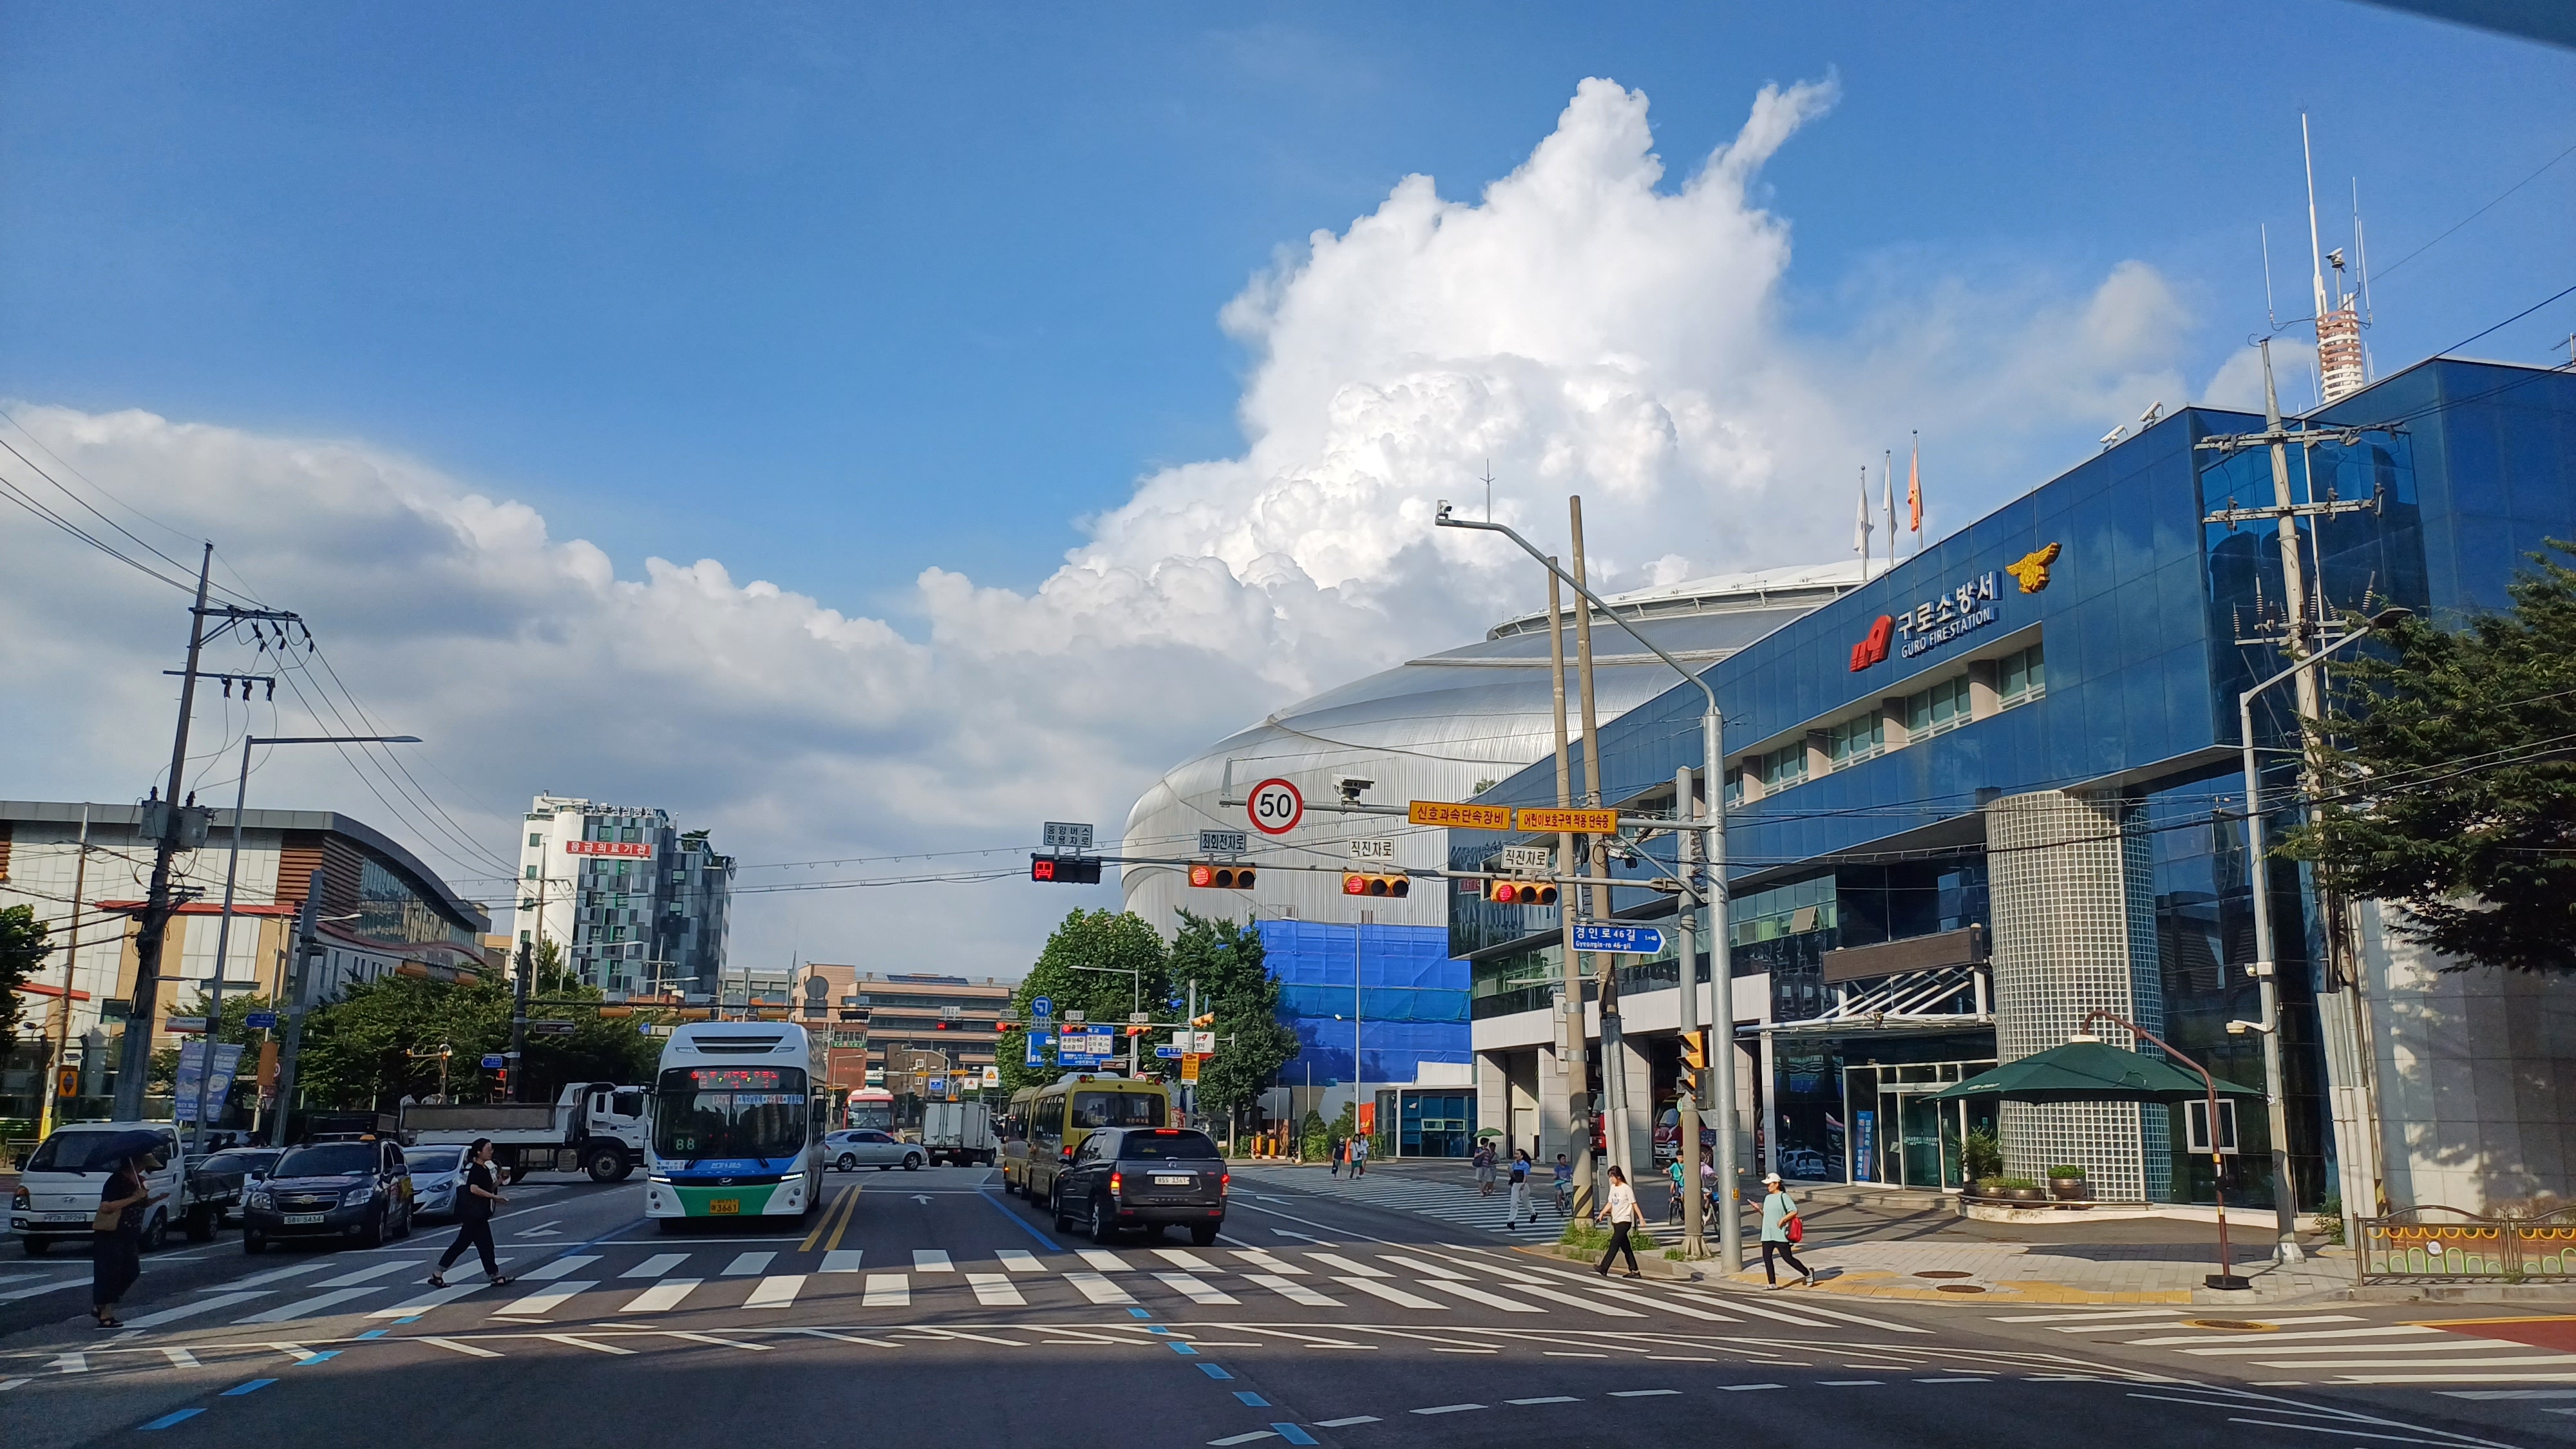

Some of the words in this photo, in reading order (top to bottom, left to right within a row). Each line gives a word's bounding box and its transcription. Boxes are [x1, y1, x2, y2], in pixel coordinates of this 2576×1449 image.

[1897, 570, 1999, 640] 구로소방서
[1901, 636, 1927, 658] GURO
[1929, 627, 1948, 646] FIRE
[1949, 606, 1991, 637] STATION
[1259, 793, 1291, 818] 50
[1417, 805, 1504, 826] 신호과속단속장비
[1524, 812, 1571, 828] 어린이보호구역
[1573, 813, 1587, 828] 적용
[1589, 813, 1609, 829] 단속중
[1046, 825, 1090, 836] 중앙버스
[571, 842, 647, 855] 응급의료기관
[1046, 835, 1090, 846] 전용차로
[1202, 835, 1244, 851] 좌회전차로
[1350, 840, 1392, 858] 직진차로
[1505, 849, 1546, 866] 직진차로
[676, 1139, 695, 1150] 88
